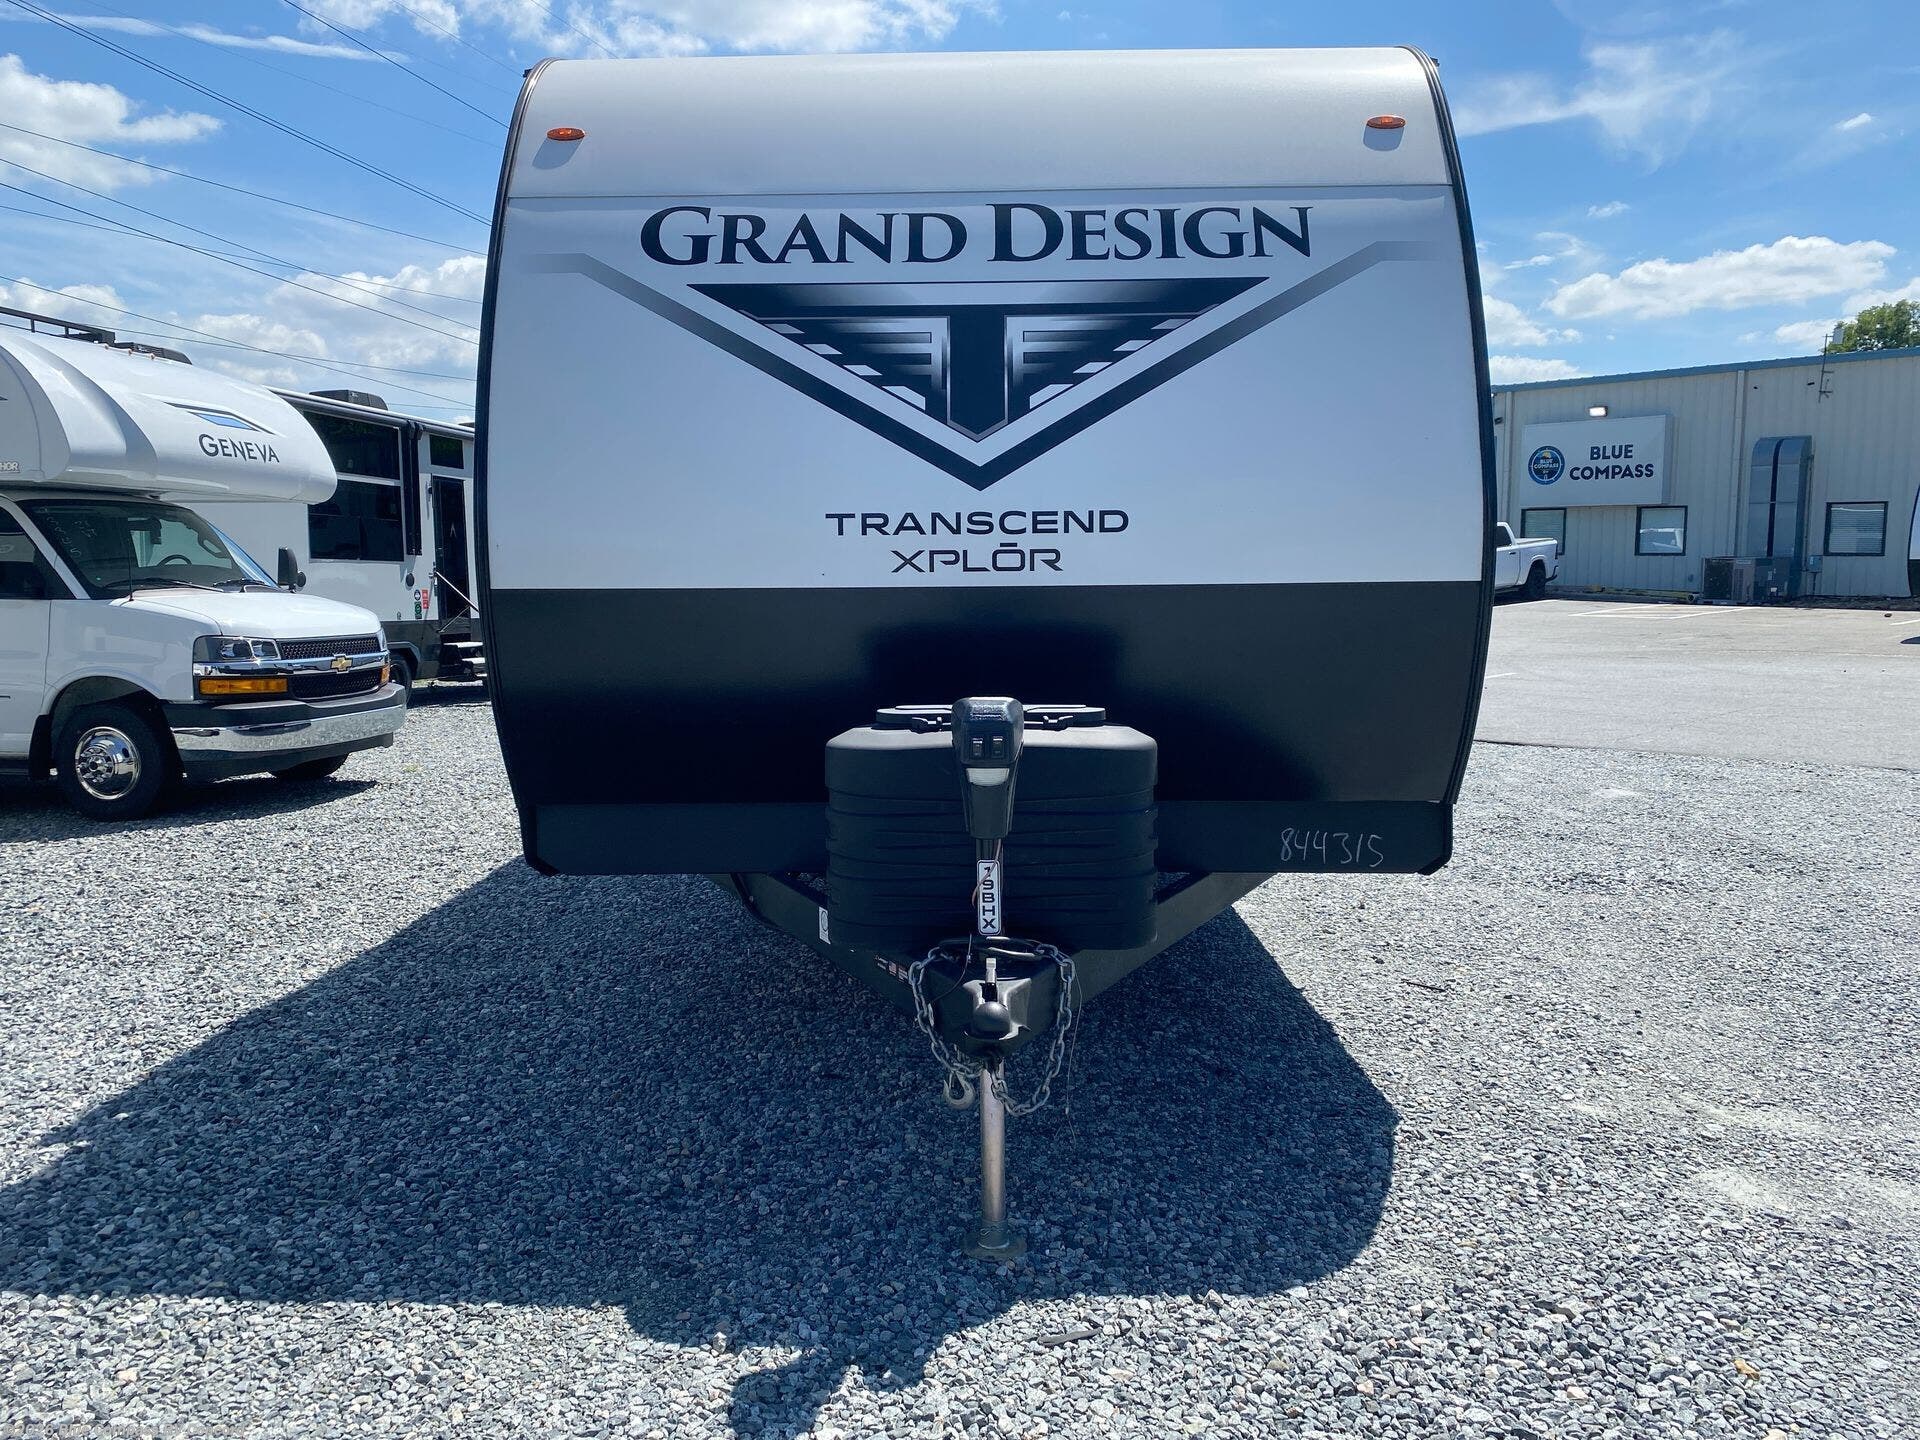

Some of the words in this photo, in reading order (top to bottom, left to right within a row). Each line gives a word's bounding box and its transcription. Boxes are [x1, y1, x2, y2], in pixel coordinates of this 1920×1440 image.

[640, 205, 967, 266] GRAND
[986, 202, 1312, 262] DESIGN
[198, 433, 280, 463] GENEVA
[1589, 444, 1634, 460] BLUE
[0, 461, 19, 471] HOR
[1569, 463, 1655, 481] COMPASS
[825, 509, 1129, 536] TRANSCEND
[1280, 826, 1384, 868] 844315
